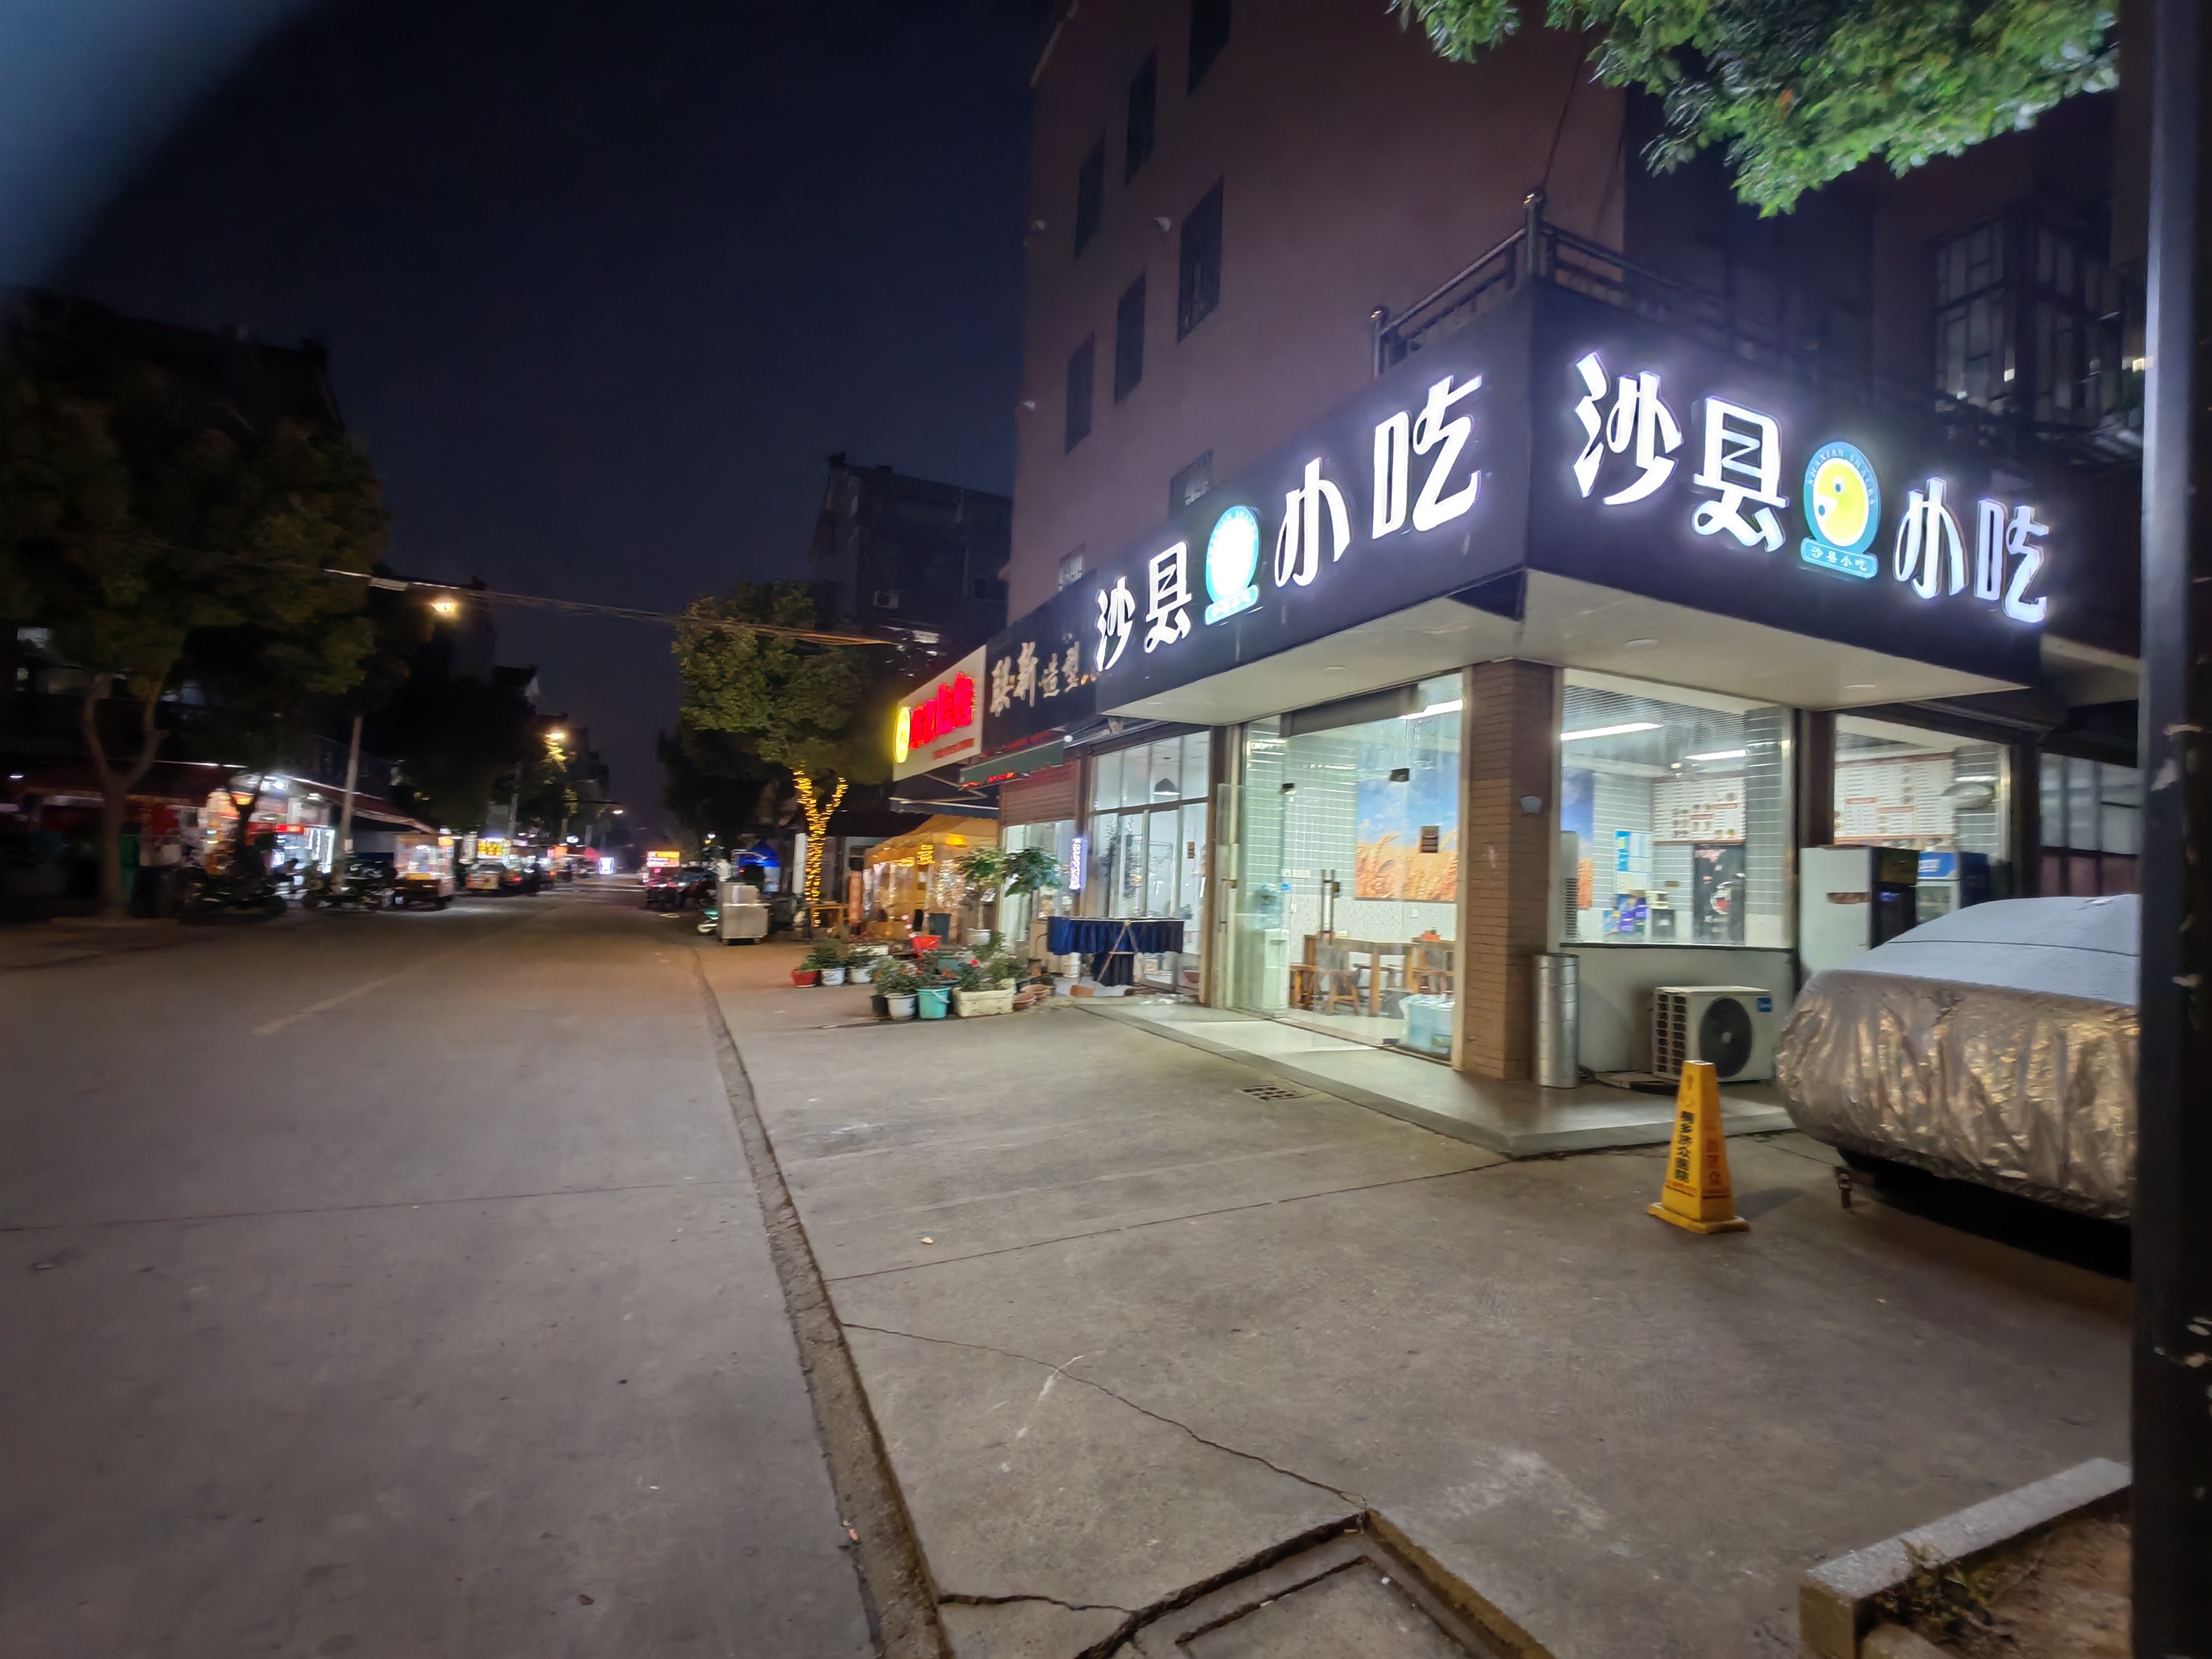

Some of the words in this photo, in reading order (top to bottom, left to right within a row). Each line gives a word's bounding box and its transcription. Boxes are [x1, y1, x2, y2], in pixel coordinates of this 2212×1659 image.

[1095, 541, 1193, 672] 沙县
[1274, 374, 1483, 588] 小吃
[1572, 351, 1790, 553] 沙县
[1893, 477, 2049, 623] 小吃
[1810, 546, 1867, 572] 沙县小吃
